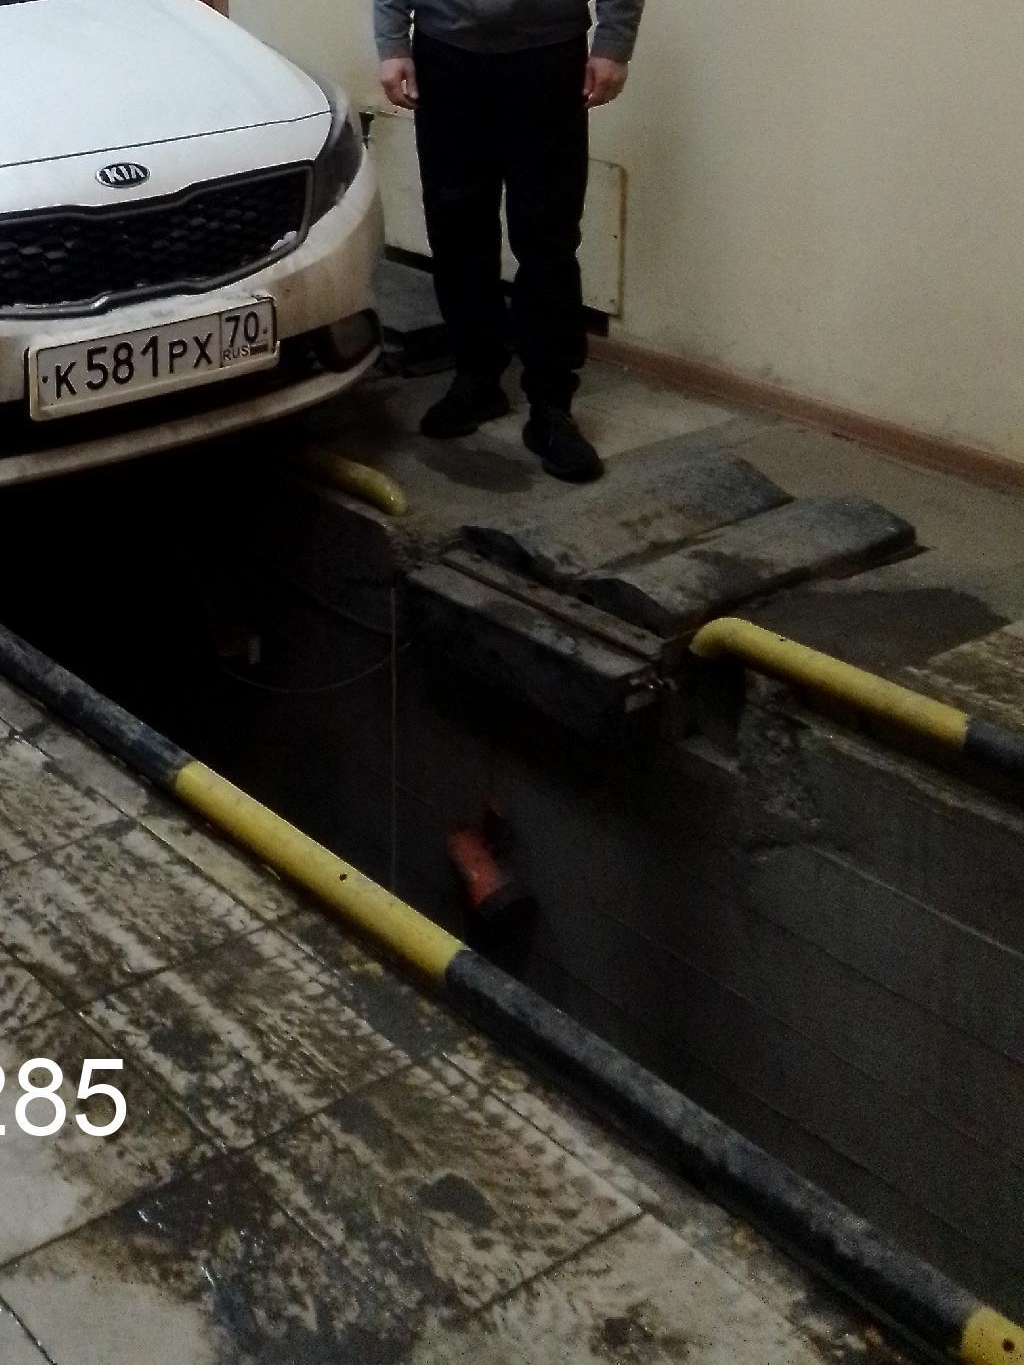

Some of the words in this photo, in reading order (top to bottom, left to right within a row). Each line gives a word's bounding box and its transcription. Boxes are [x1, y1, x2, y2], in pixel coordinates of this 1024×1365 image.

[102, 164, 146, 183] KIA
[224, 310, 260, 348] 70
[222, 344, 250, 362] RUS
